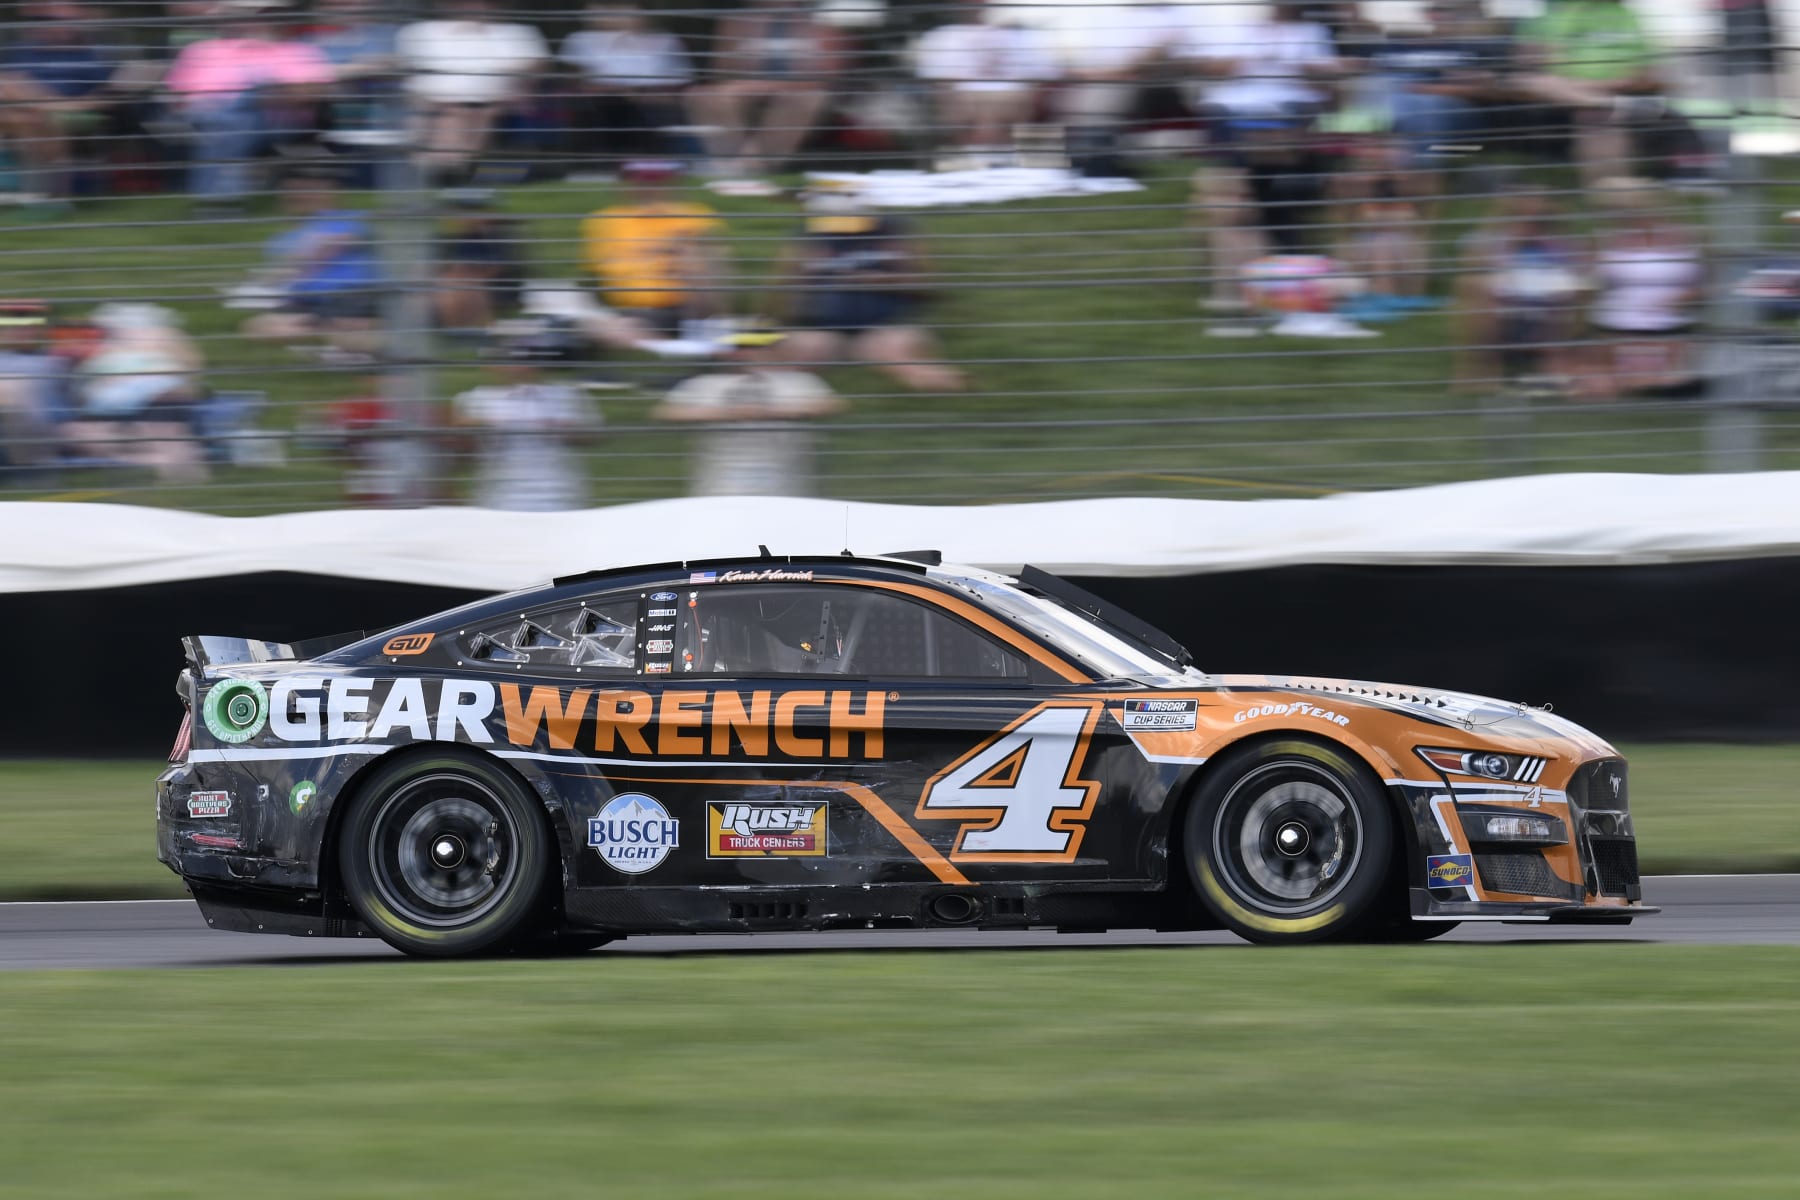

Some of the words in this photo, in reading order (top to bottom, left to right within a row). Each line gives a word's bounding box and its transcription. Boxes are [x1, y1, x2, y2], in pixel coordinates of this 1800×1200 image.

[648, 624, 675, 632] HAAS
[1148, 701, 1188, 712] NASCAR
[1133, 715, 1154, 725] CUP
[1154, 715, 1187, 725] SERIES
[1233, 701, 1350, 727] GOODYEAR
[918, 702, 1101, 861] 4
[1523, 786, 1544, 808] 4
[198, 807, 221, 815] PIZZA
[588, 819, 678, 846] BUSCH
[729, 837, 761, 848] TRUCK
[762, 837, 806, 848] CENTERS
[607, 846, 660, 859] LIGHT
[1430, 866, 1471, 878] SUNOCO
